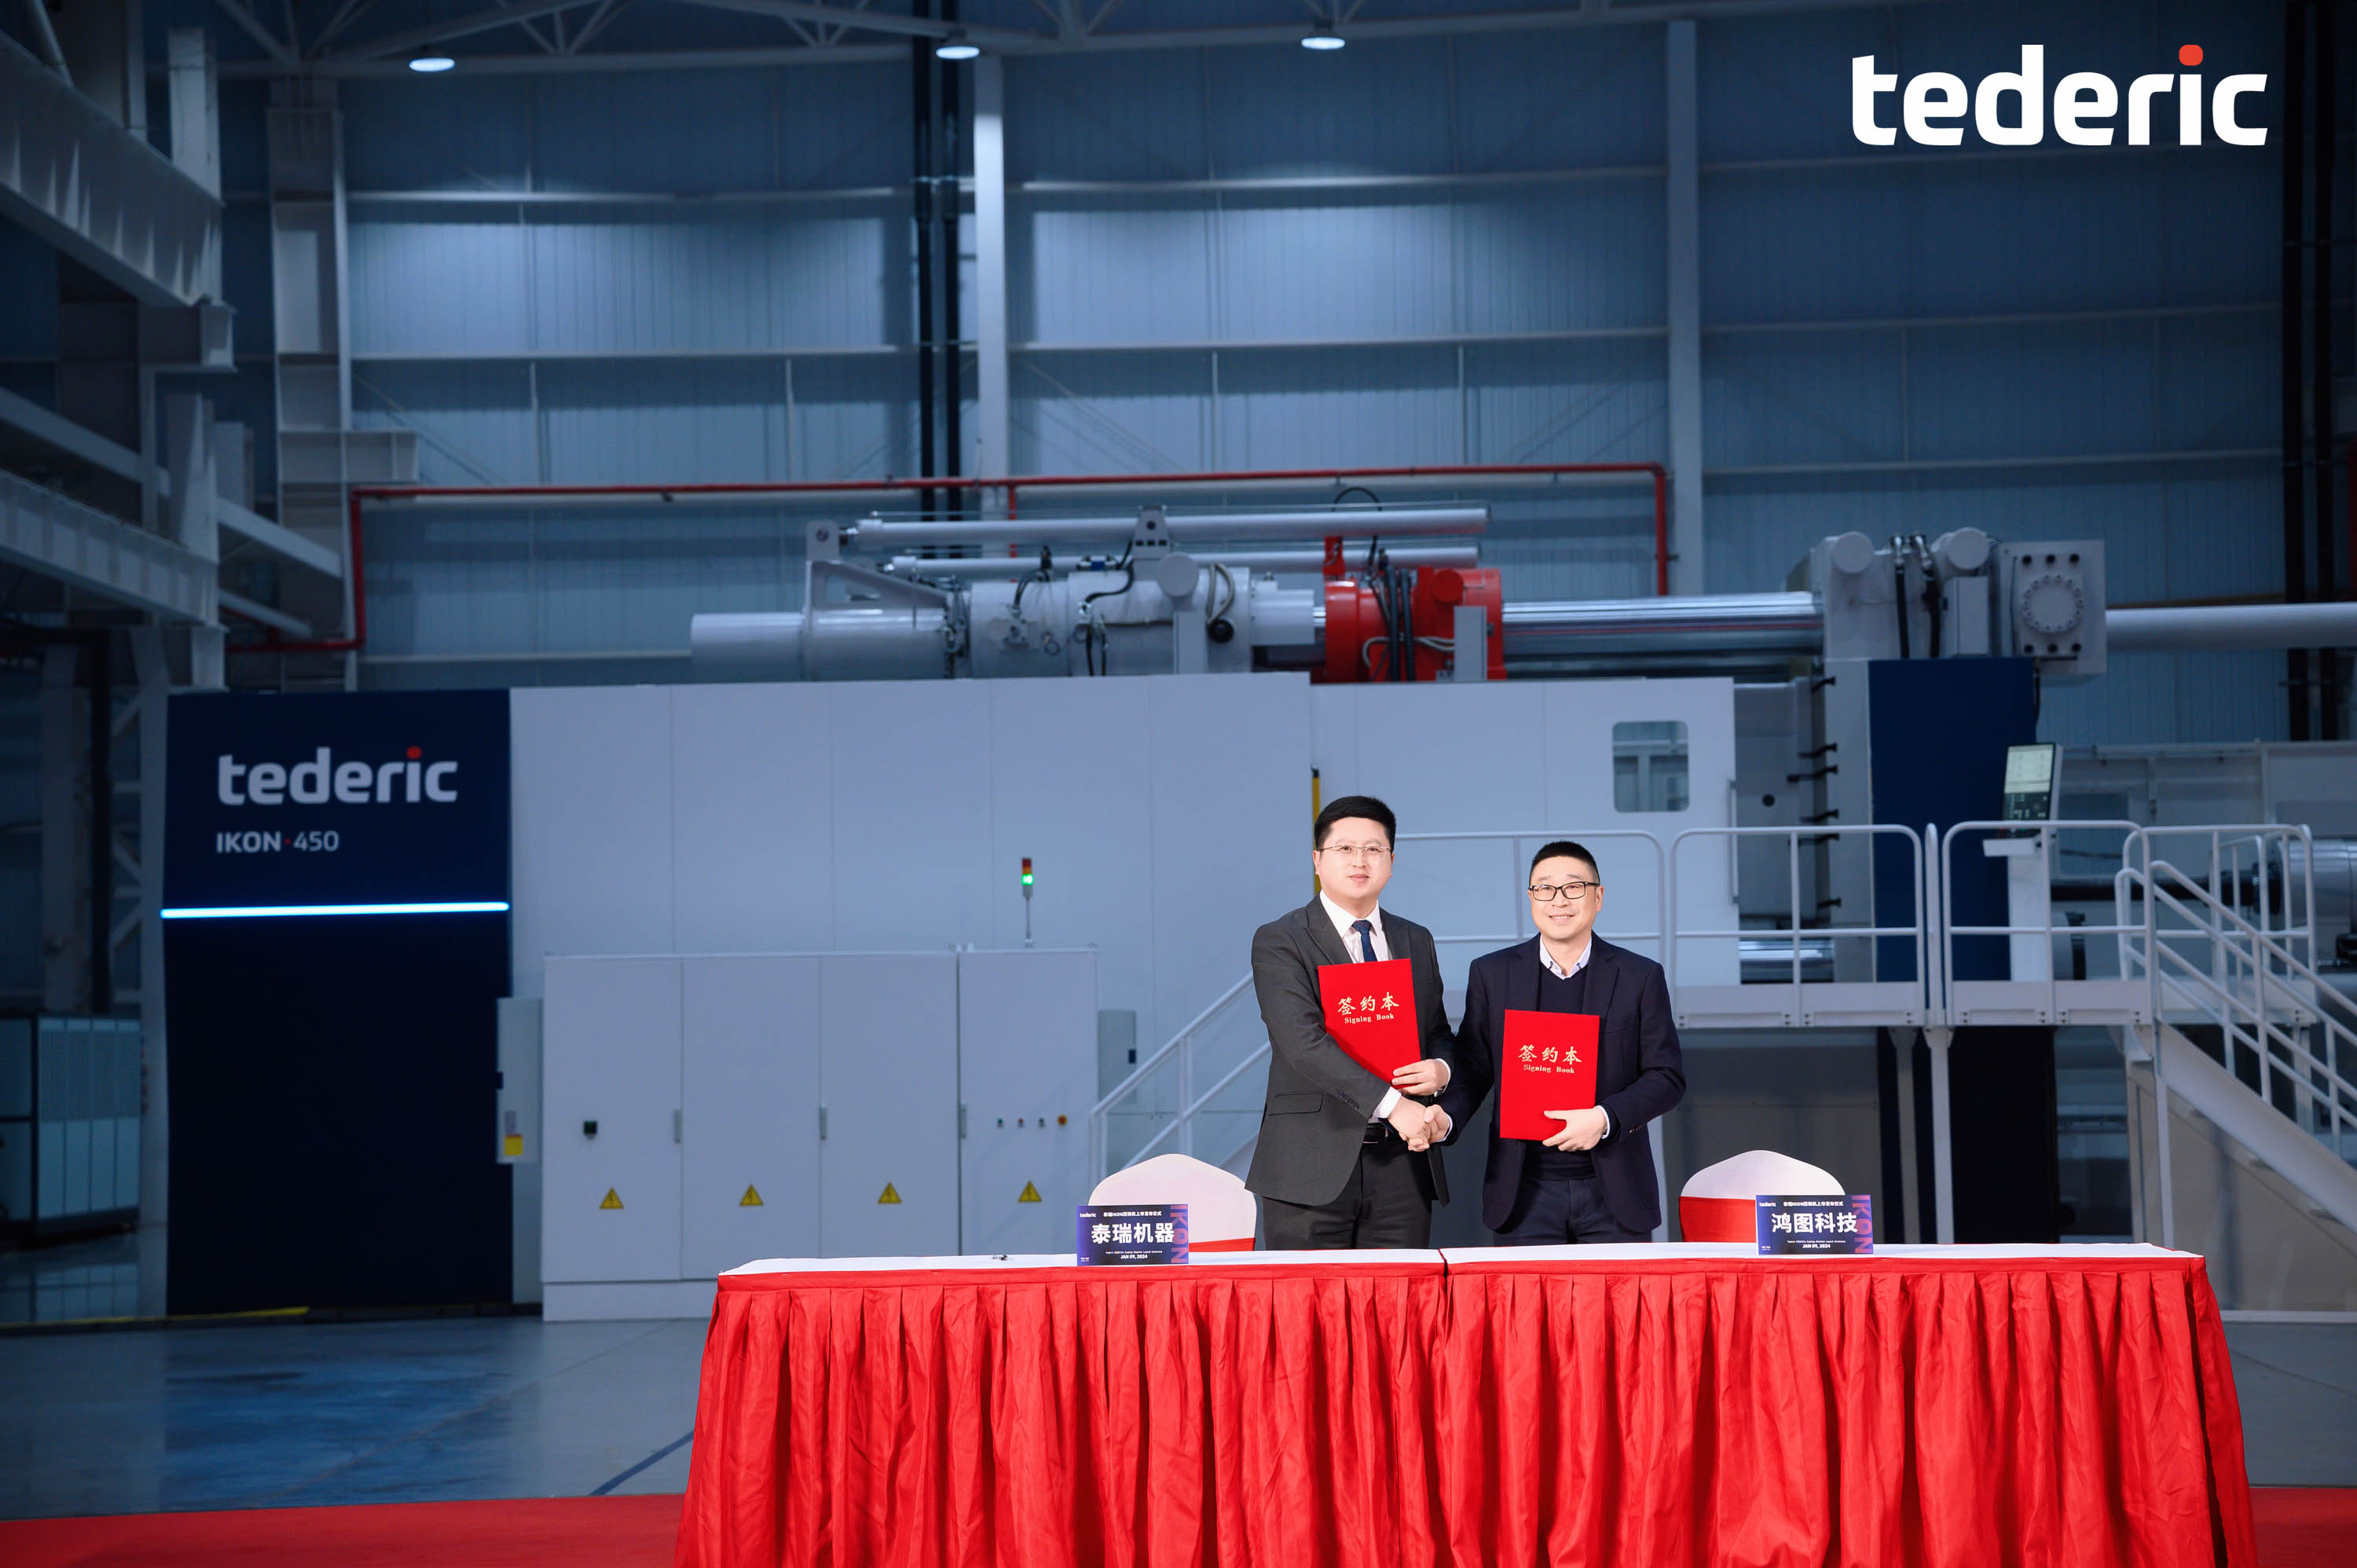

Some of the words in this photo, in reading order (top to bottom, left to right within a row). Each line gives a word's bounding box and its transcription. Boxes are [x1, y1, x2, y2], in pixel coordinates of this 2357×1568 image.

[218, 746, 458, 806] tederic
[1337, 991, 1400, 1016] 签约本
[1344, 1014, 1373, 1024] Signing
[1376, 1013, 1395, 1021] Book
[1517, 1044, 1582, 1066] 签约本
[1523, 1064, 1552, 1074] Signing
[1556, 1065, 1575, 1075] Book
[1091, 1222, 1175, 1244] 泰瑞机器
[1771, 1212, 1858, 1233] 鸿图科技
